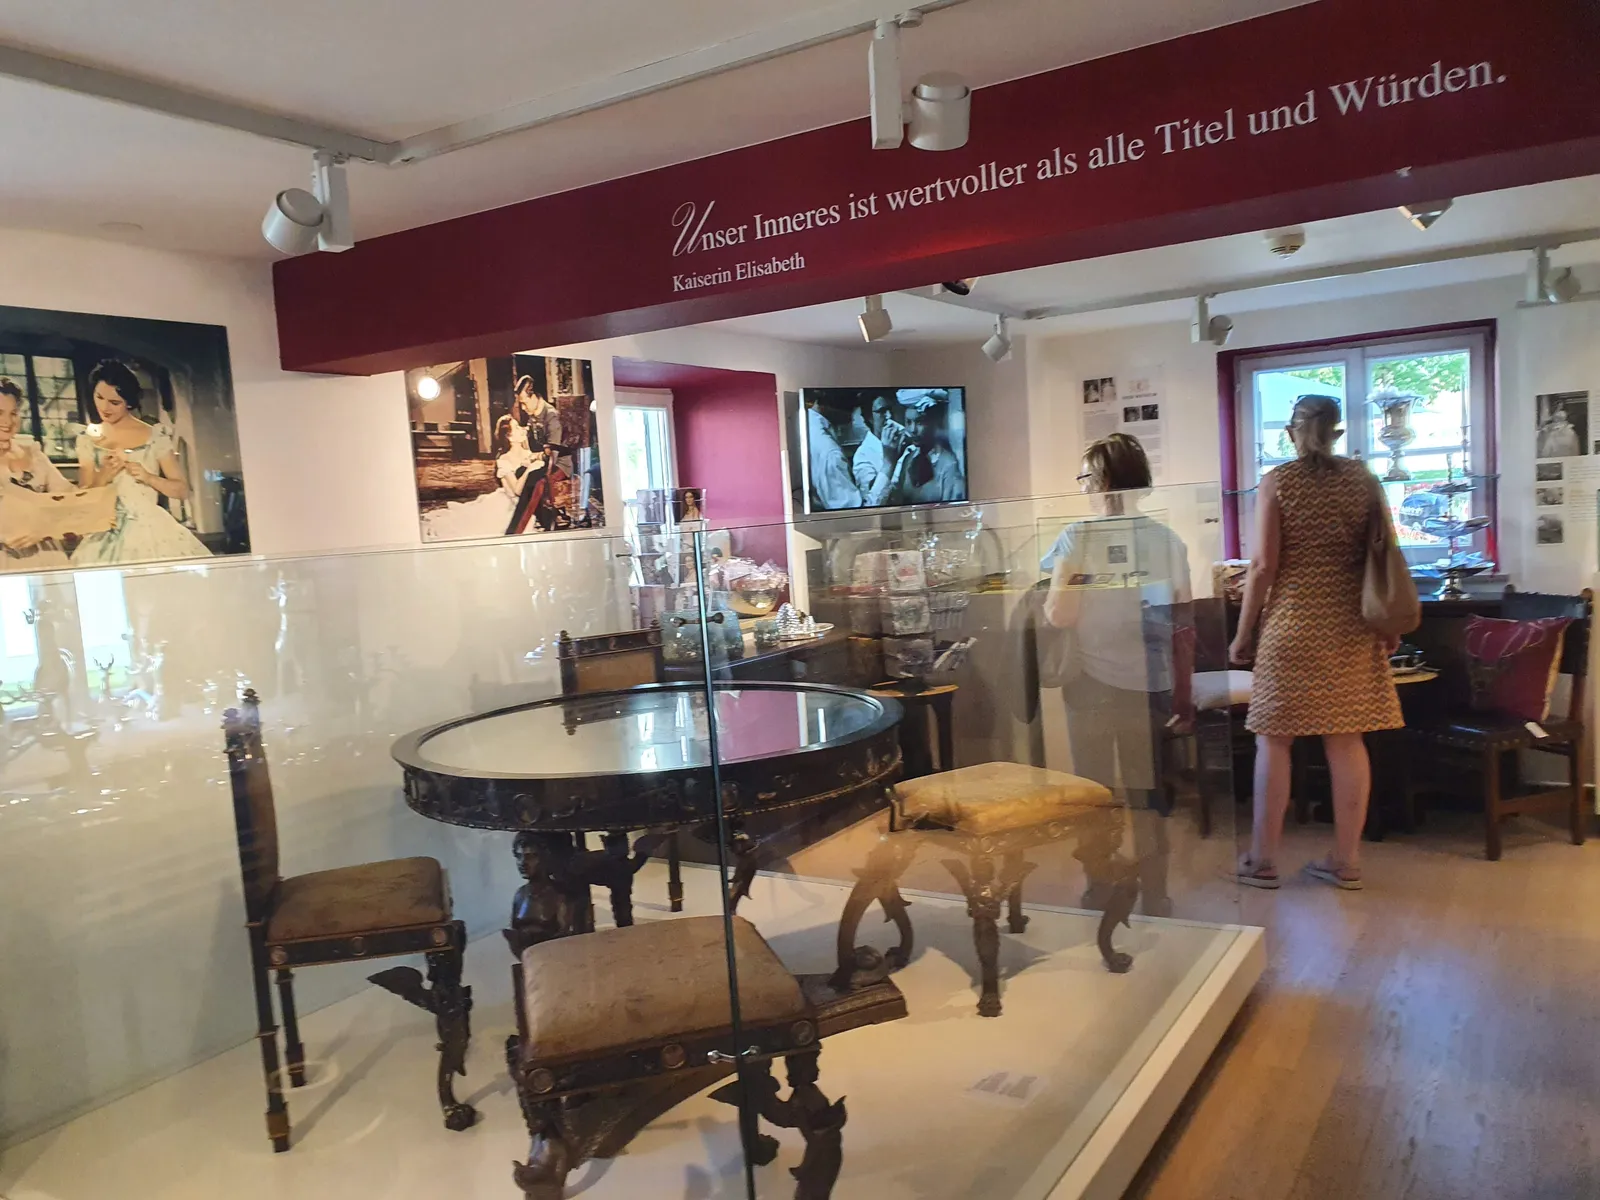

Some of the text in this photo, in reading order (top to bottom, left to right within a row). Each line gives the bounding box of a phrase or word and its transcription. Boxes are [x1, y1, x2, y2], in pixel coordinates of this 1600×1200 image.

[671, 59, 1507, 256] Unser Inneres ist wertvoller als alle Titel und Würden.
[673, 253, 805, 292] Kaiserin Elisabeth
